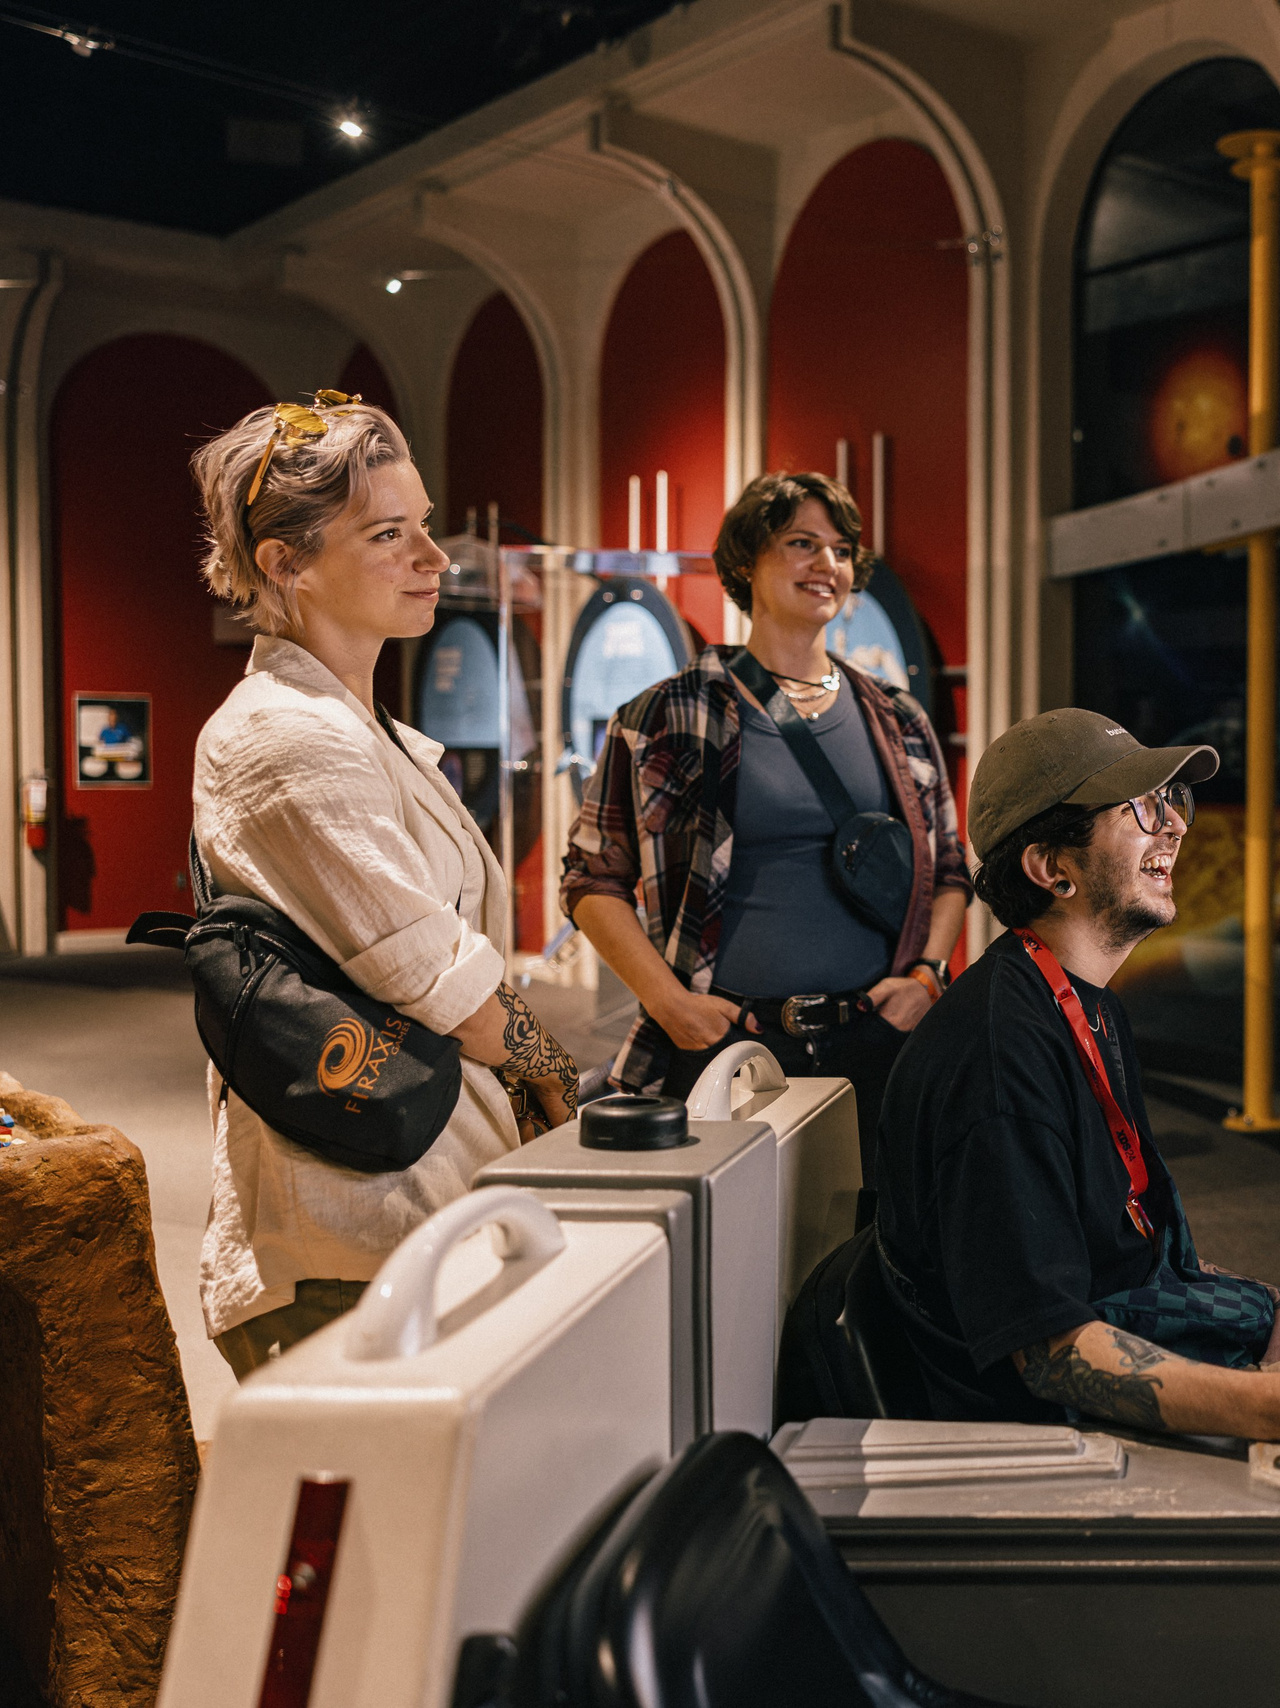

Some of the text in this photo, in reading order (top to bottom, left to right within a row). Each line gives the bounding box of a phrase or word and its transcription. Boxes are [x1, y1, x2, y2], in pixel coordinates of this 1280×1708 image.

[390, 1021, 411, 1056] GAMES
[344, 1017, 402, 1114] FIRAXIS
[1115, 1128, 1136, 1162] XDS24
